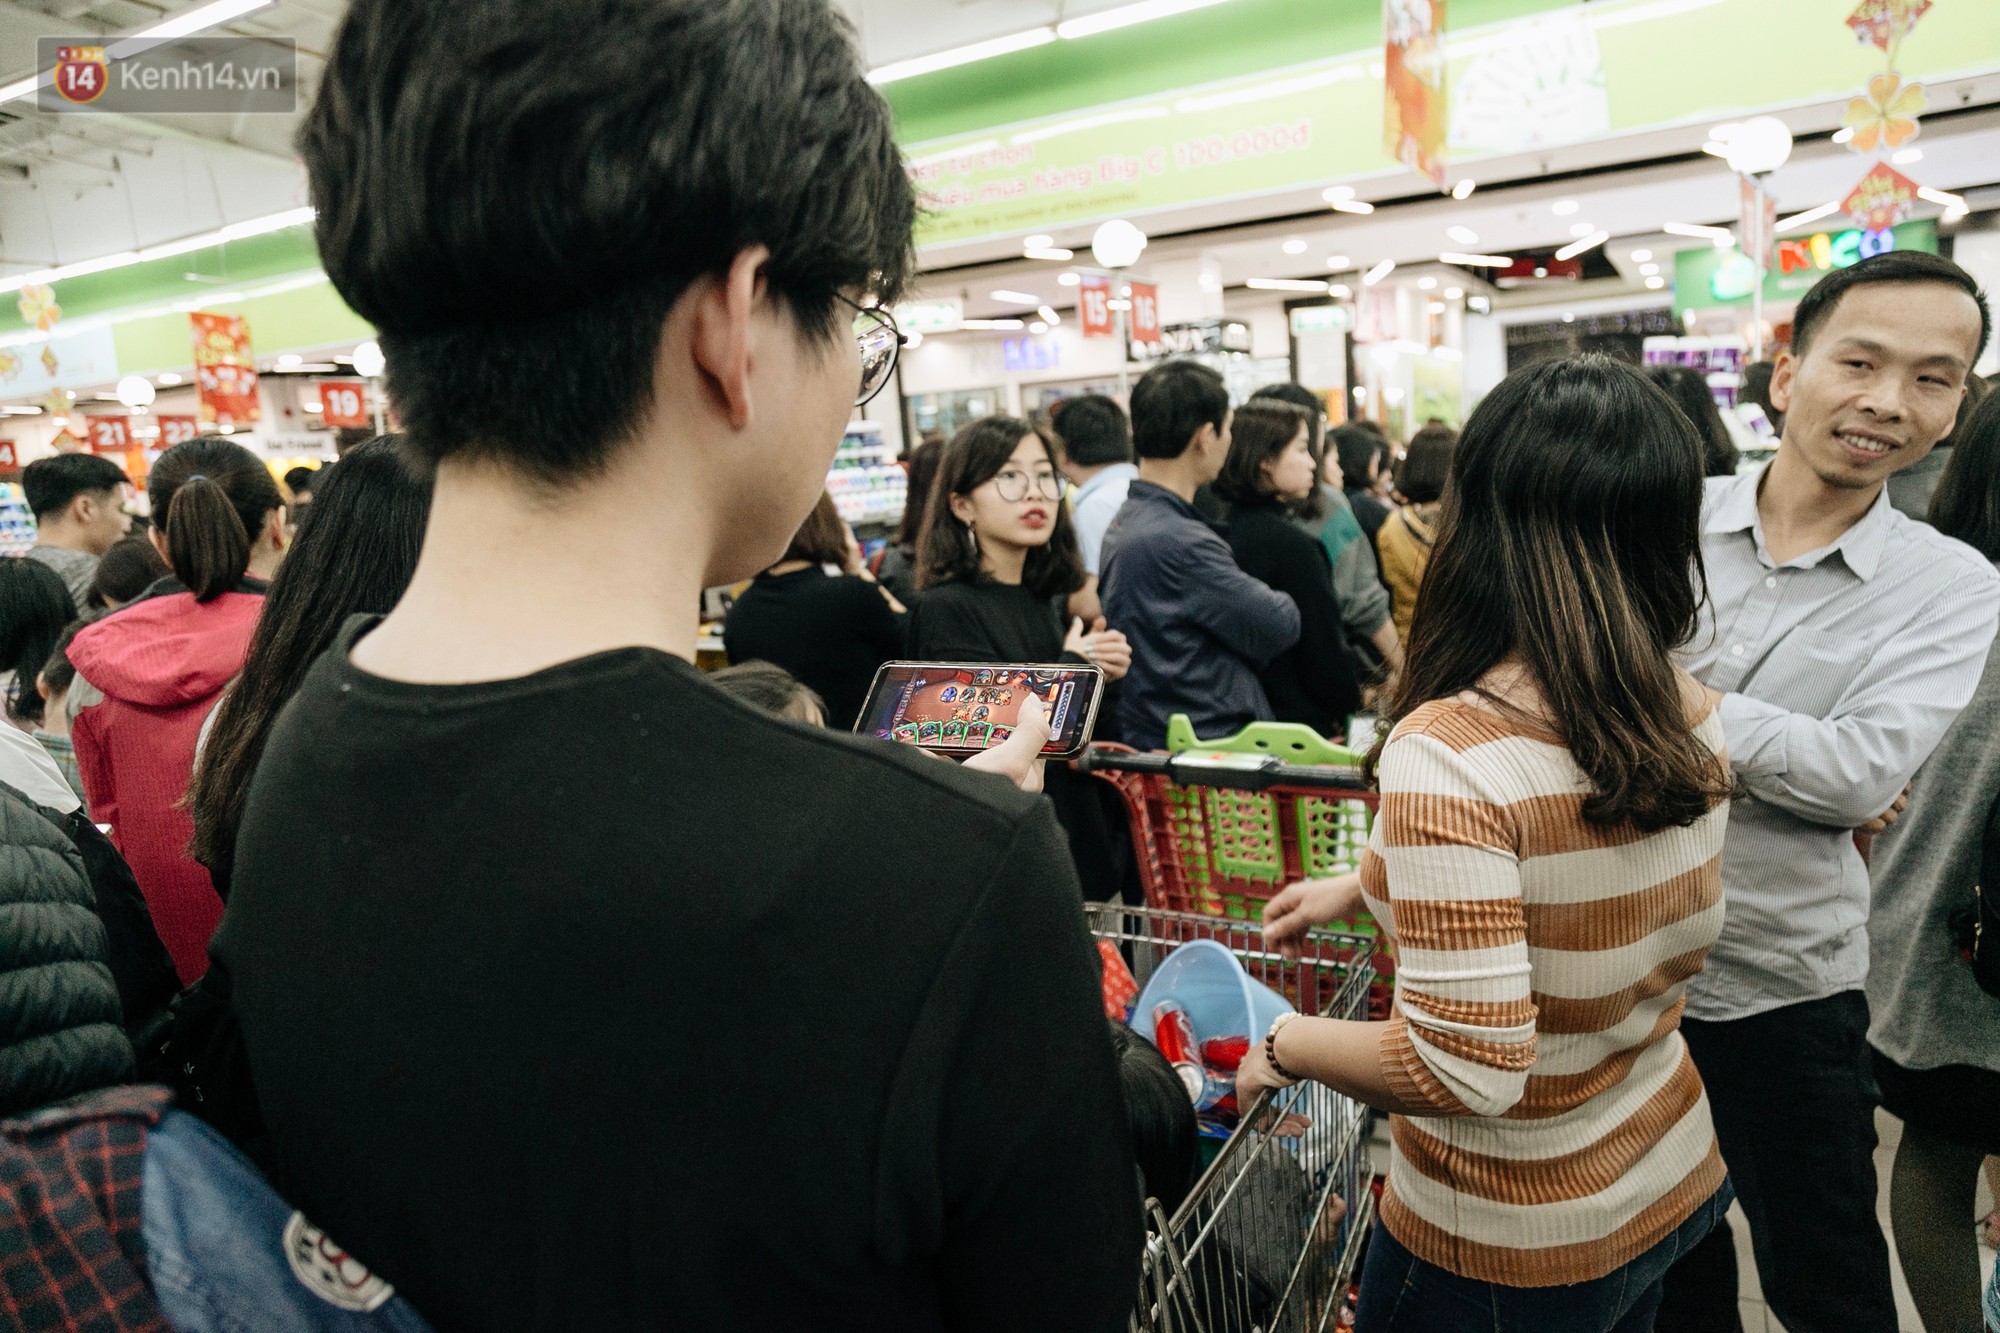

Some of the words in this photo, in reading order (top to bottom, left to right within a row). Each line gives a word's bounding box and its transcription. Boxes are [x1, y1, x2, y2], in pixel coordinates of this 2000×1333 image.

[1083, 289, 1108, 326] 15
[1134, 295, 1156, 329] 16
[327, 389, 360, 417] 19
[96, 421, 126, 446] 21
